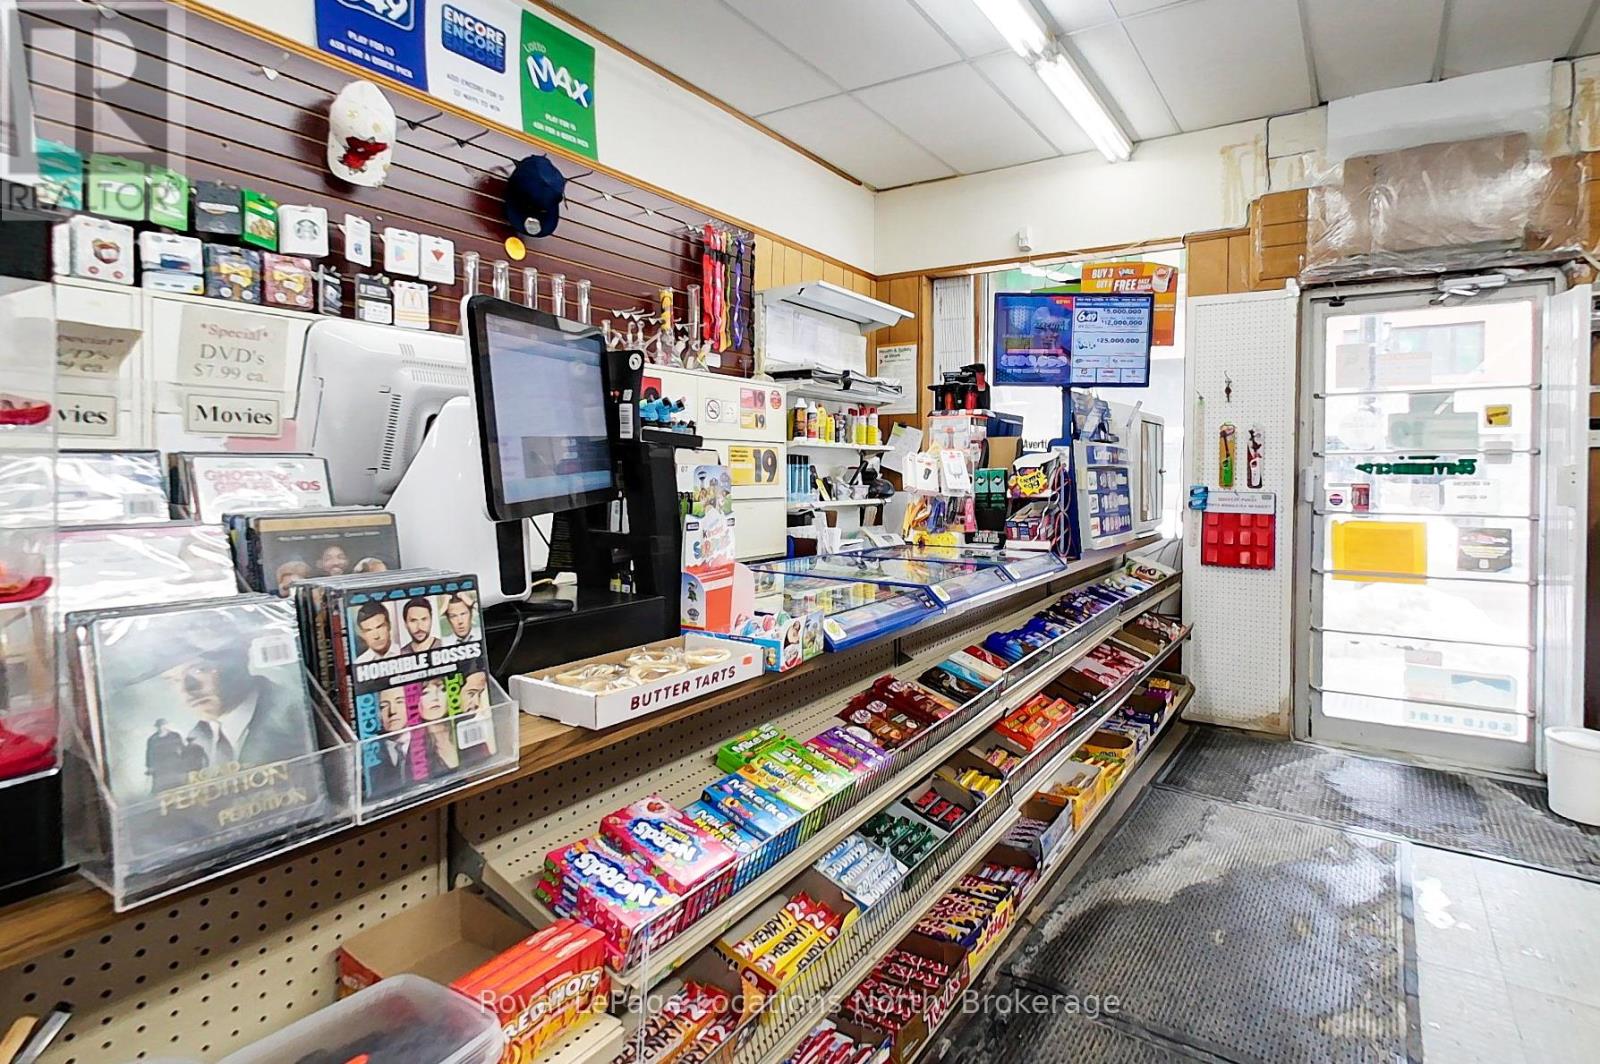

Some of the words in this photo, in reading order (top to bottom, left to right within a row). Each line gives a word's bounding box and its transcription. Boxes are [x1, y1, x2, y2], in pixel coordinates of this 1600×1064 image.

[444, 7, 504, 46] ENCORE
[444, 20, 504, 58] ENCORE
[1113, 279, 1138, 292] FREE
[200, 343, 266, 365] DVD's
[753, 389, 766, 408] 19
[194, 404, 273, 425] Movies
[754, 413, 765, 428] 19
[753, 448, 778, 483] 19
[356, 652, 429, 683] HORRIBLE
[430, 642, 482, 667] BOSSES
[630, 682, 690, 711] BUTTER
[694, 665, 737, 690] TARTS
[826, 842, 868, 876] BOUNTY
[549, 970, 601, 1009] HOTS
